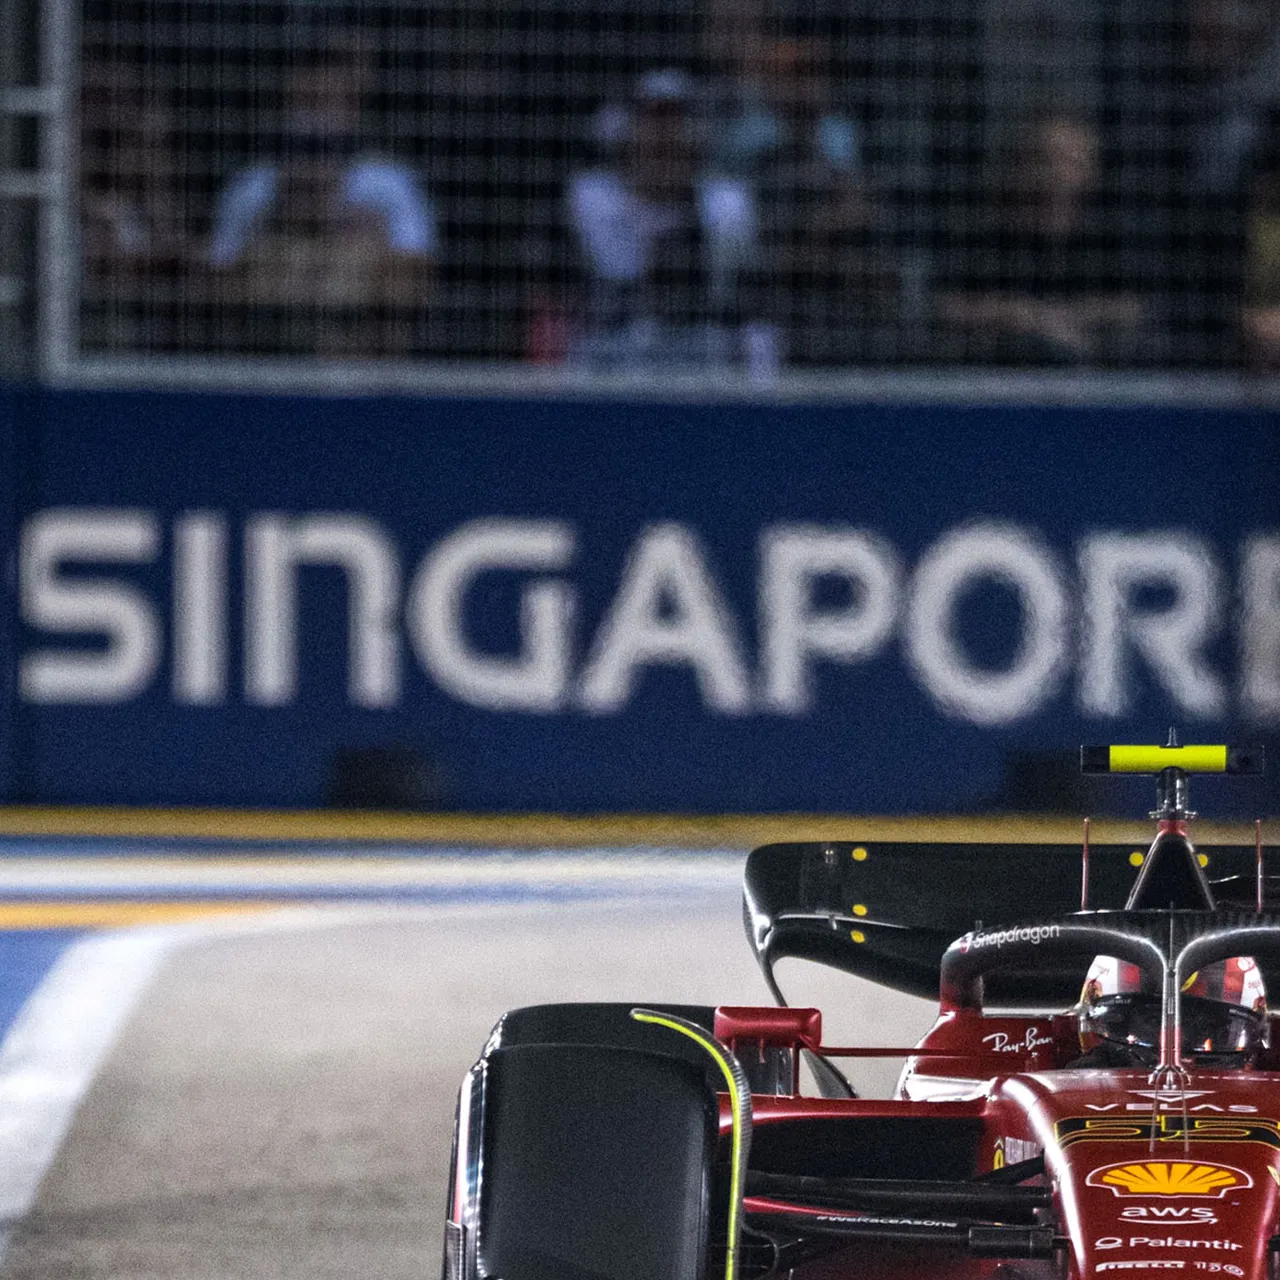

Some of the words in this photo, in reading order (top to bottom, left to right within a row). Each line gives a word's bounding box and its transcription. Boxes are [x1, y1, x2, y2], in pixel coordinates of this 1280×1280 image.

[973, 925, 1060, 949] Snapdragon
[982, 1027, 1054, 1053] Ray-Ban
[1084, 1103, 1259, 1113] VELAS
[1121, 1206, 1215, 1218] aws
[816, 1215, 958, 1228] #WeRaceAsOne
[1129, 1236, 1243, 1251] Palantir
